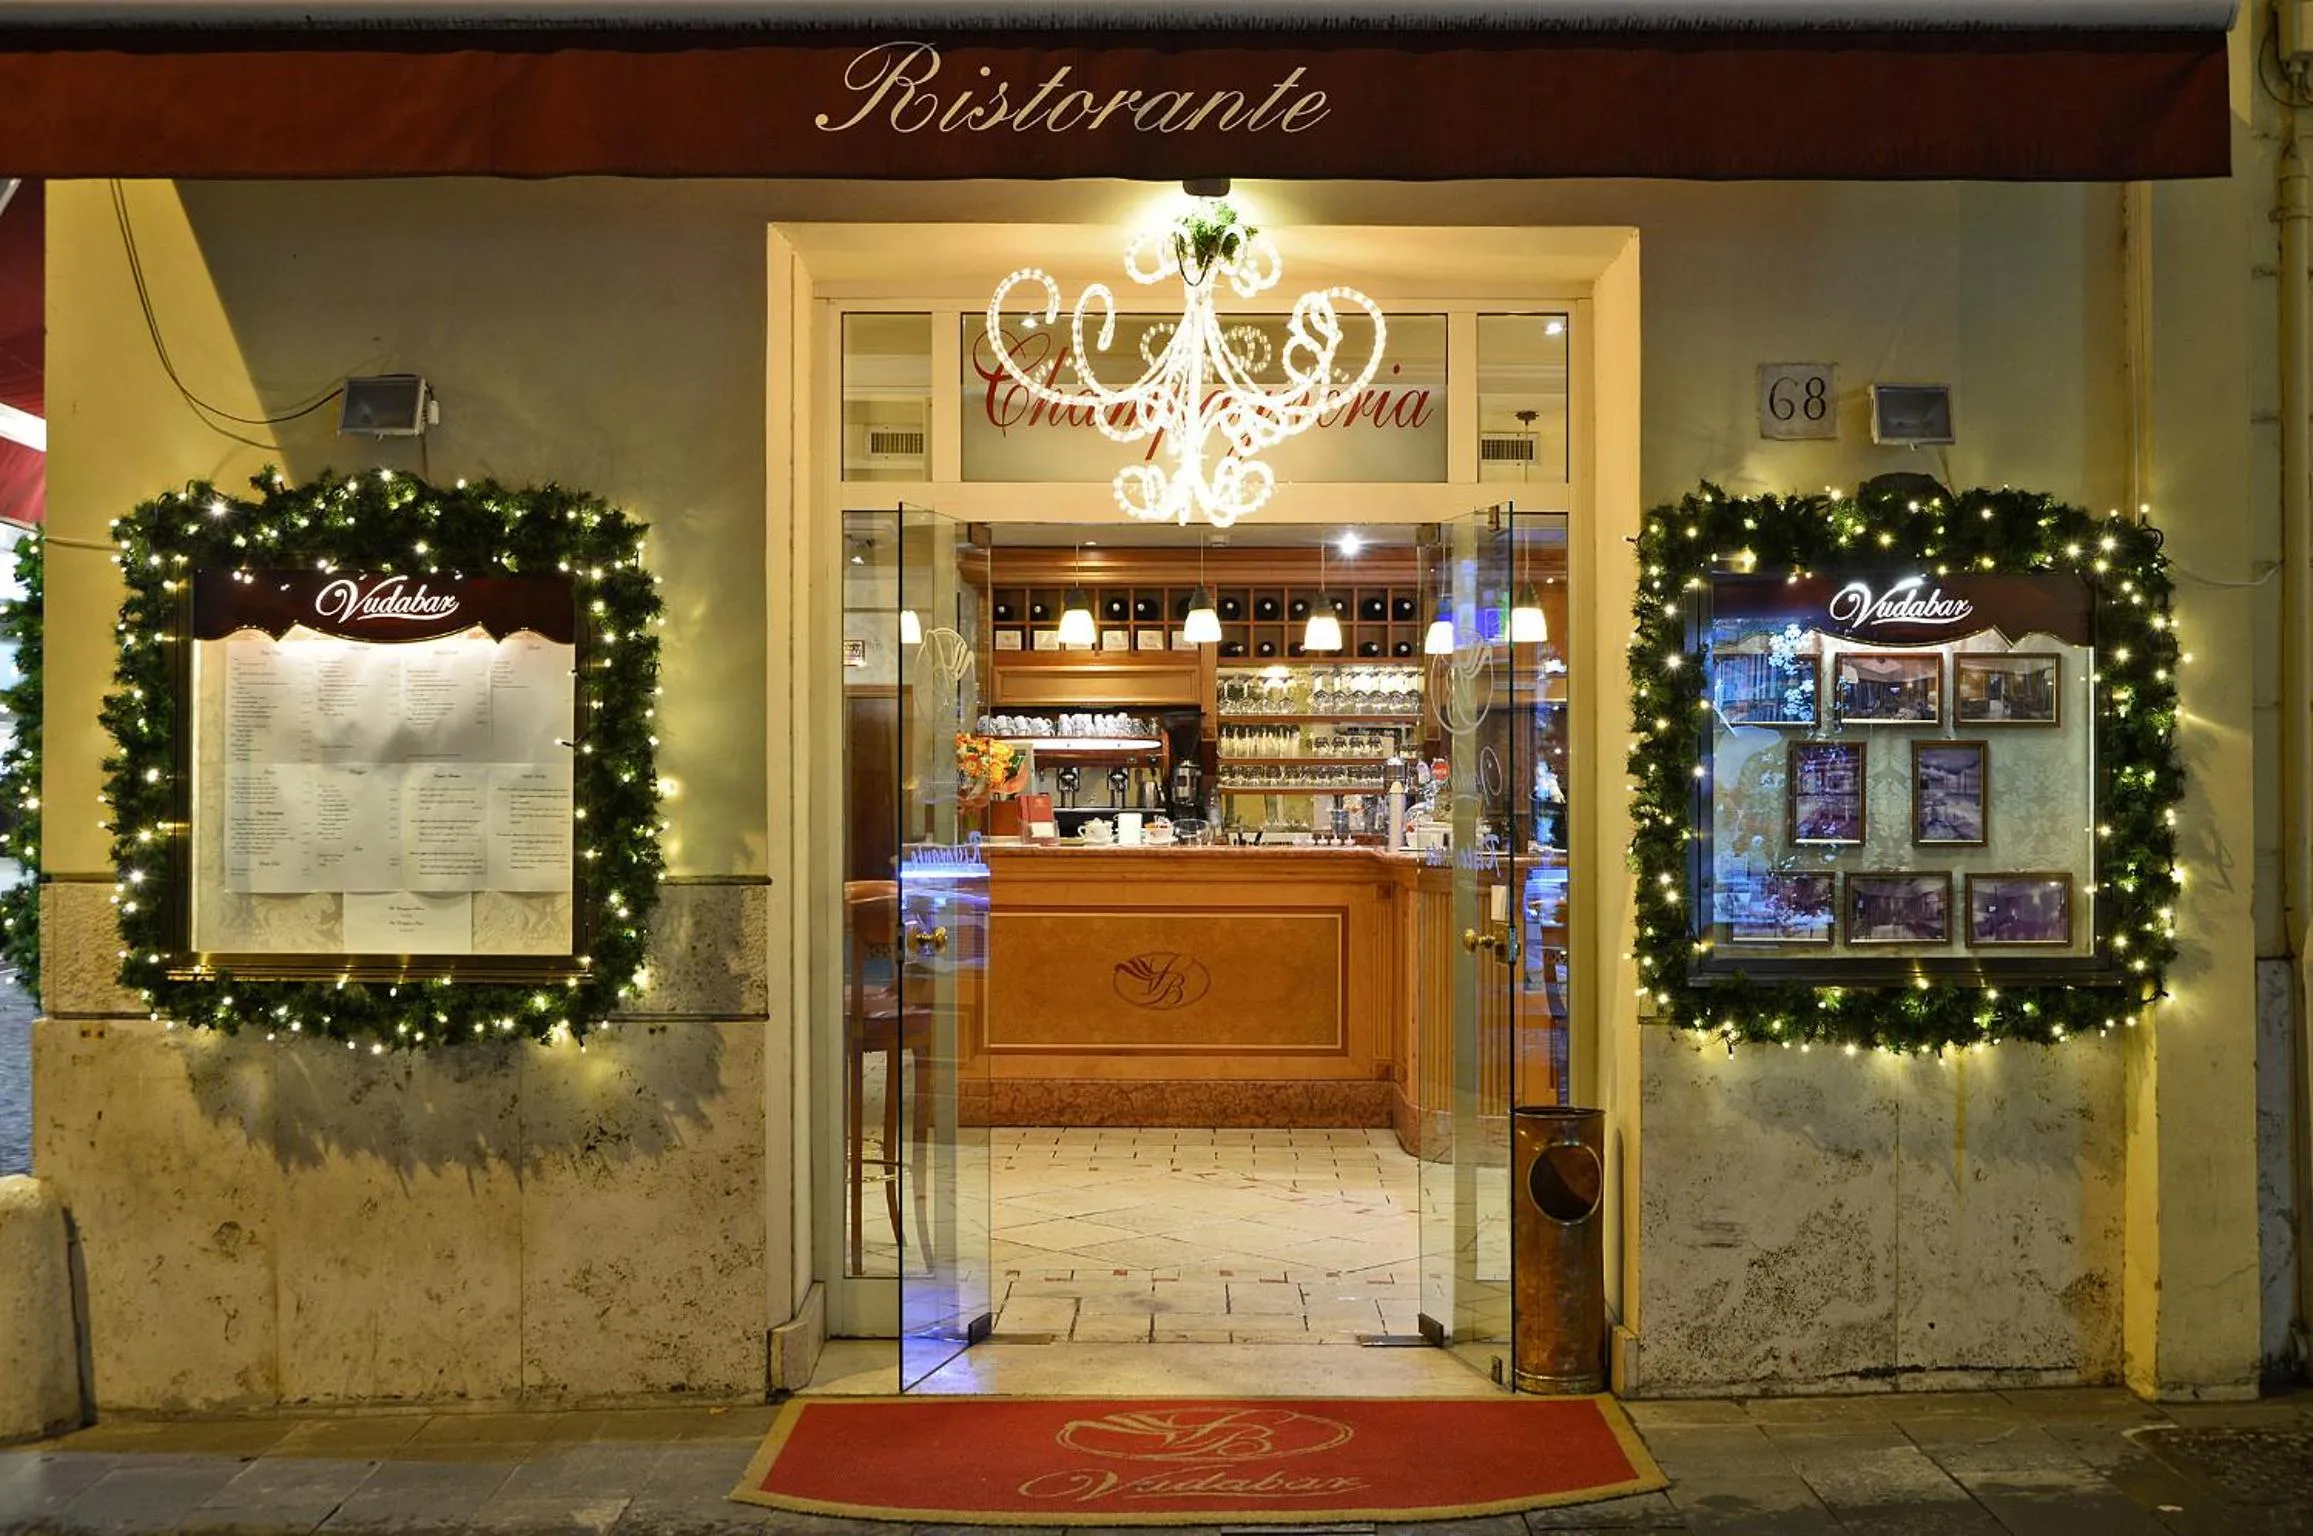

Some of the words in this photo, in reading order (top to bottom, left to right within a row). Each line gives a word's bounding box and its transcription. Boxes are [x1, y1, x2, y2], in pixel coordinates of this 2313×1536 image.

[814, 41, 1332, 133] Ristorante
[972, 328, 1435, 462] Champeria
[1768, 376, 1826, 420] 68
[315, 574, 460, 624] Vudabar
[1829, 576, 1974, 629] Vudabar
[1017, 1464, 1372, 1501] Vudabar
